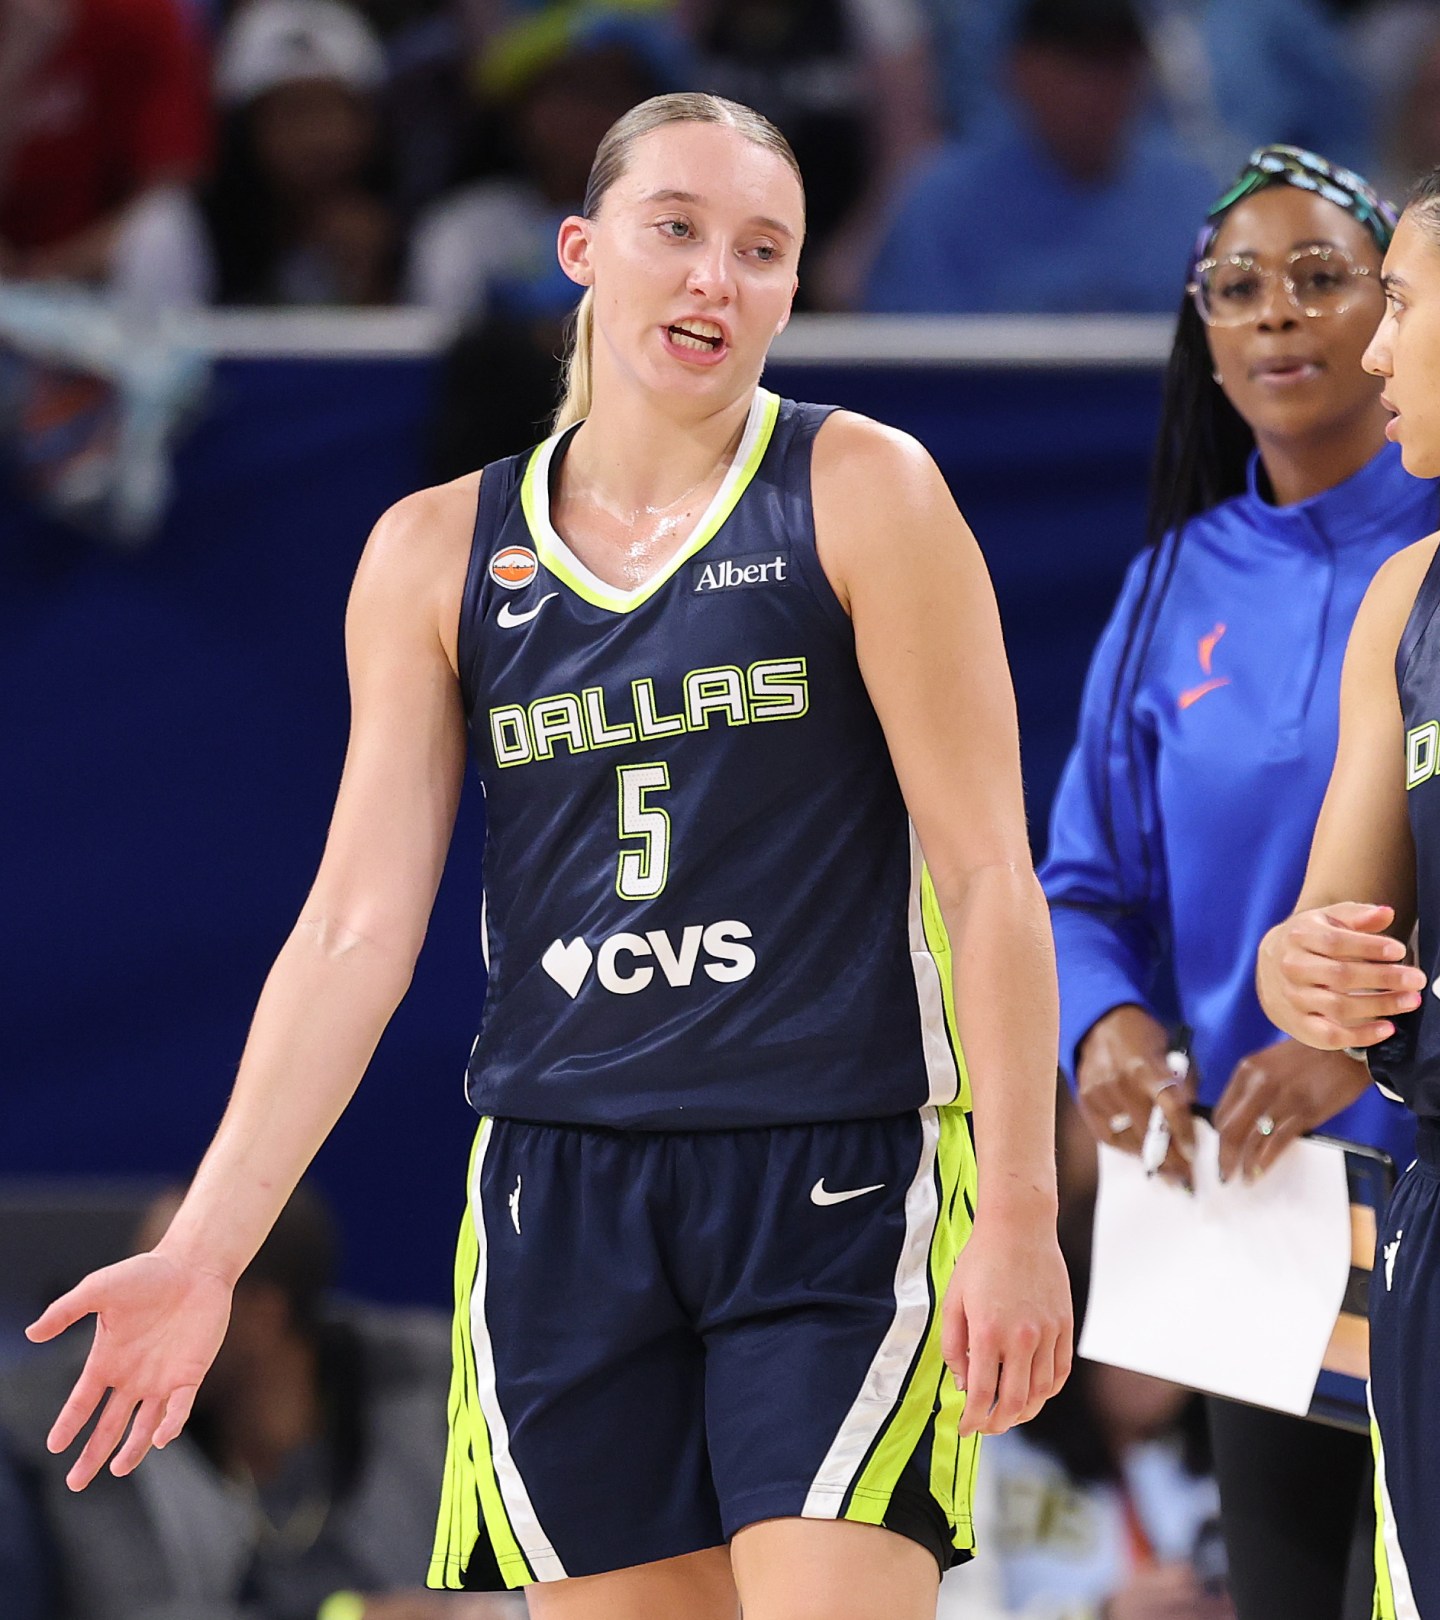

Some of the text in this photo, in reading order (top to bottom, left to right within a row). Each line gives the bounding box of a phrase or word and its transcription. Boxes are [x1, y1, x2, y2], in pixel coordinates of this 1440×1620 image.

[693, 556, 787, 592] Albert
[489, 656, 809, 768] DALLAS
[616, 761, 671, 901] 5
[596, 920, 756, 995] CVS
